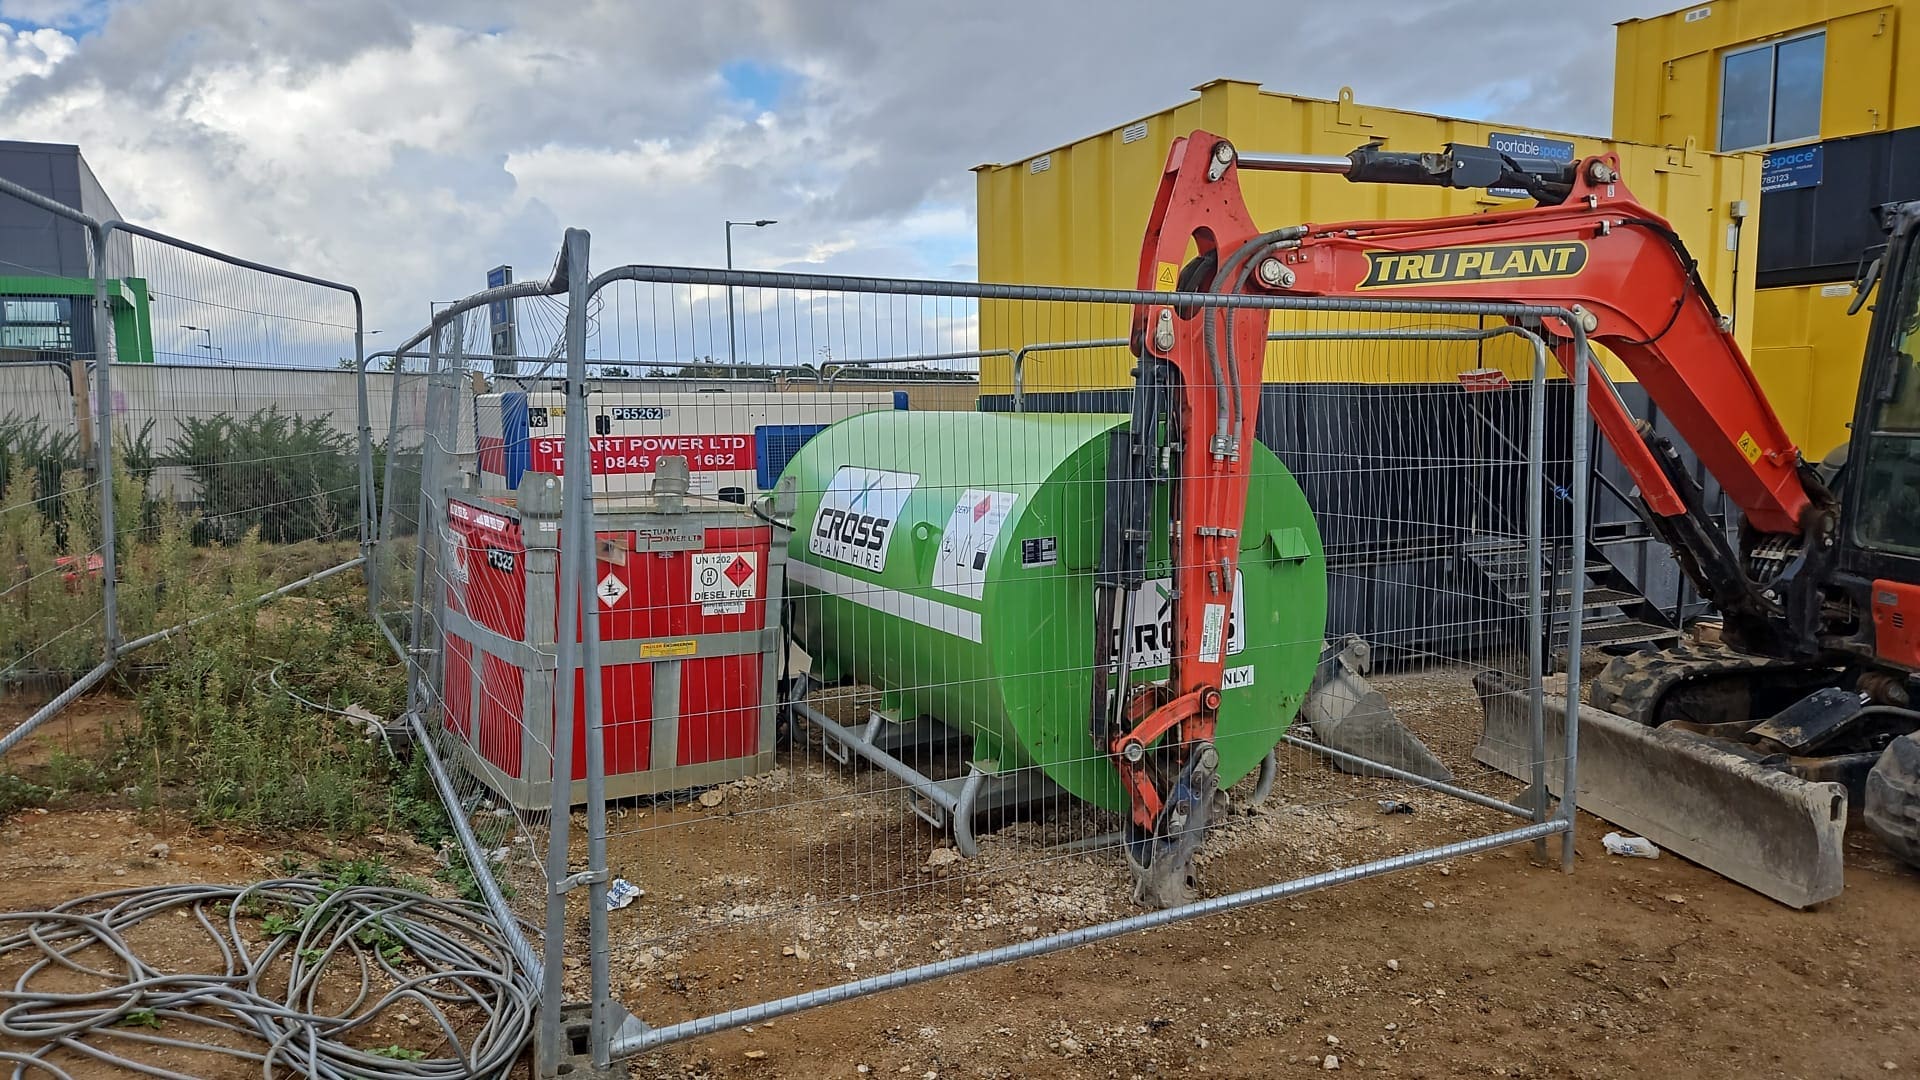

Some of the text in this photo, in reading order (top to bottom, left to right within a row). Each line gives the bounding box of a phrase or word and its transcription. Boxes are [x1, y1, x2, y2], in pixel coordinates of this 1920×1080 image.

[1375, 247, 1576, 281] TRU PLANT
[613, 408, 661, 420] P65262
[539, 437, 745, 454] START POWER LTD
[605, 455, 650, 469] 0845
[694, 453, 735, 466] 1662
[817, 507, 890, 551] CROSS
[696, 555, 731, 565] UN 1202
[813, 539, 880, 569] PLANT HIRE
[695, 589, 753, 601] DIESEL FUEL
[1223, 669, 1249, 685] NLY
